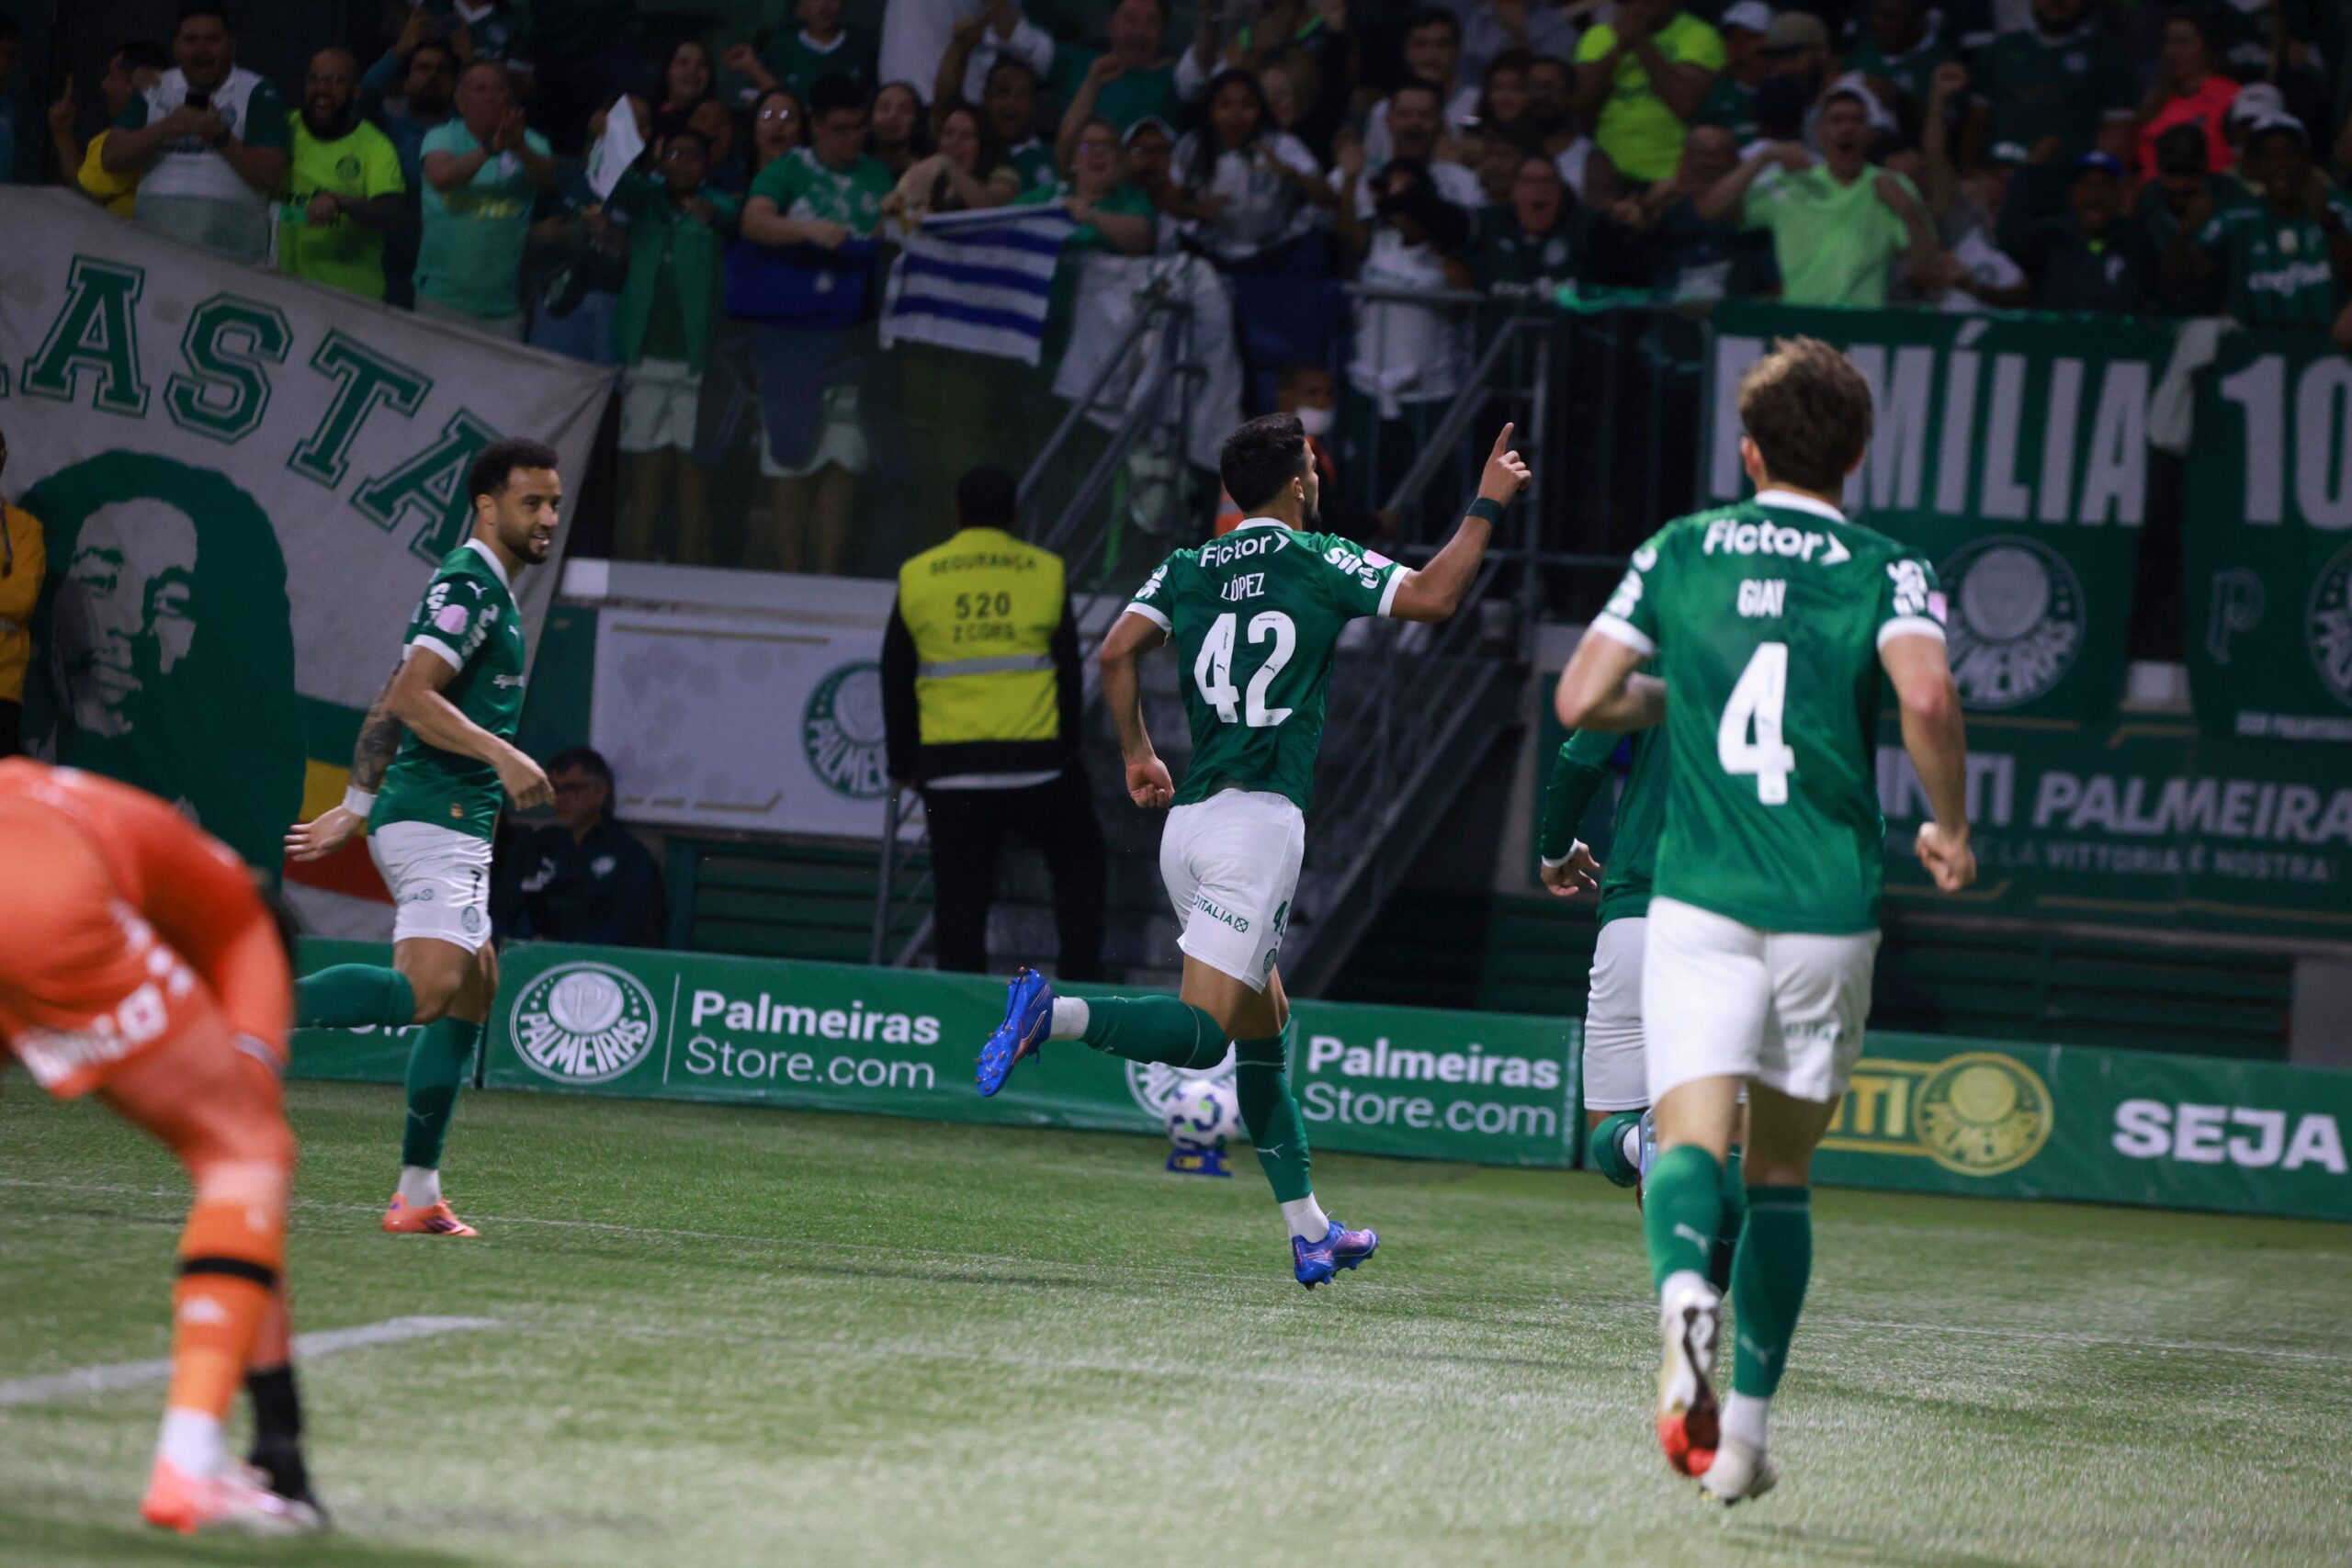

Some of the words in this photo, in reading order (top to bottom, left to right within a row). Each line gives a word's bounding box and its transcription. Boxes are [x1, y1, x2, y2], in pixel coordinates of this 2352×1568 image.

[0, 254, 505, 570] ASTA
[1200, 534, 1272, 568] Fictor
[1702, 519, 1824, 562] Fictor
[954, 591, 1012, 620] 520
[1220, 572, 1265, 602] LÓPEZ
[1736, 579, 1787, 618] GIAY
[1194, 611, 1296, 728] 42
[1717, 642, 1795, 806] 4
[520, 1011, 649, 1076] PALMEIRAS
[691, 989, 941, 1044] Palmeiras
[685, 1035, 935, 1089] Store.com
[1306, 1035, 1560, 1090] Palmeiras
[1302, 1081, 1556, 1137] Store.com
[2112, 1099, 2348, 1174] SEJA
